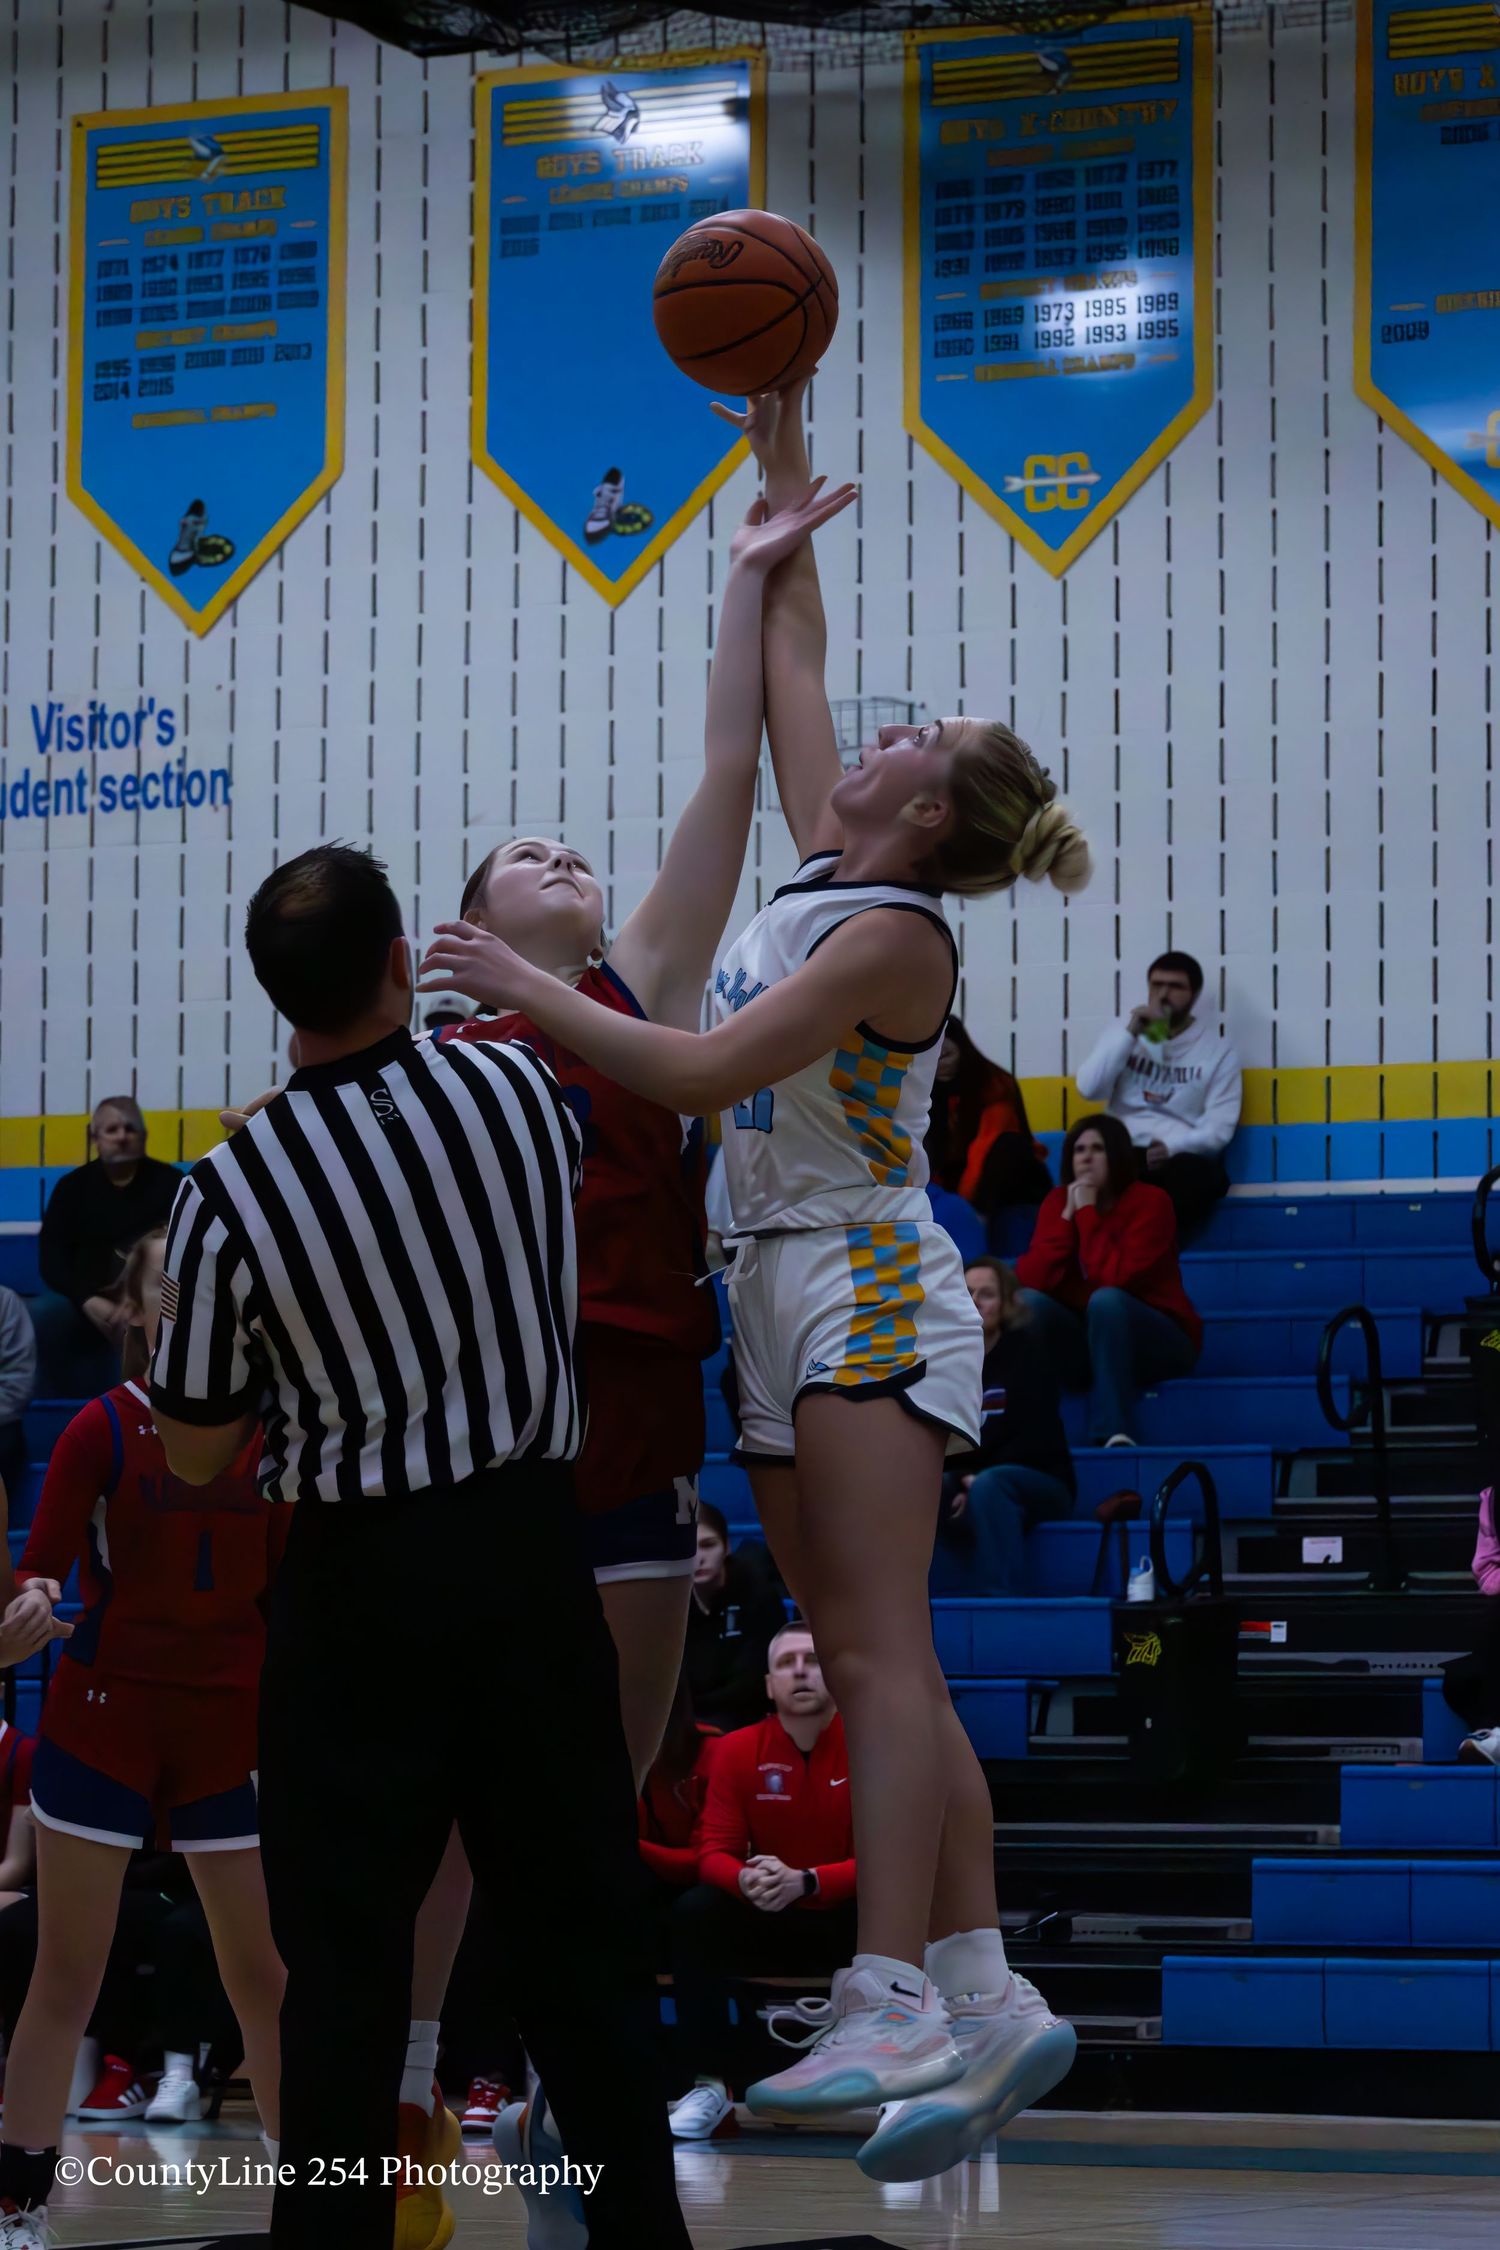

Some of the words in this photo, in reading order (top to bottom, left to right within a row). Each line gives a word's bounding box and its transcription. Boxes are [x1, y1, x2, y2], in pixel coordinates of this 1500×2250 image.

[613, 140, 704, 173] TRACK
[1034, 302, 1074, 323] 1973
[1085, 298, 1126, 318] 1985
[1137, 292, 1179, 314] 1989
[1034, 328, 1075, 349] 1992
[1085, 324, 1126, 344] 1993
[1137, 319, 1179, 340] 1995
[31, 697, 176, 754] Visitor's
[99, 756, 232, 813] section
